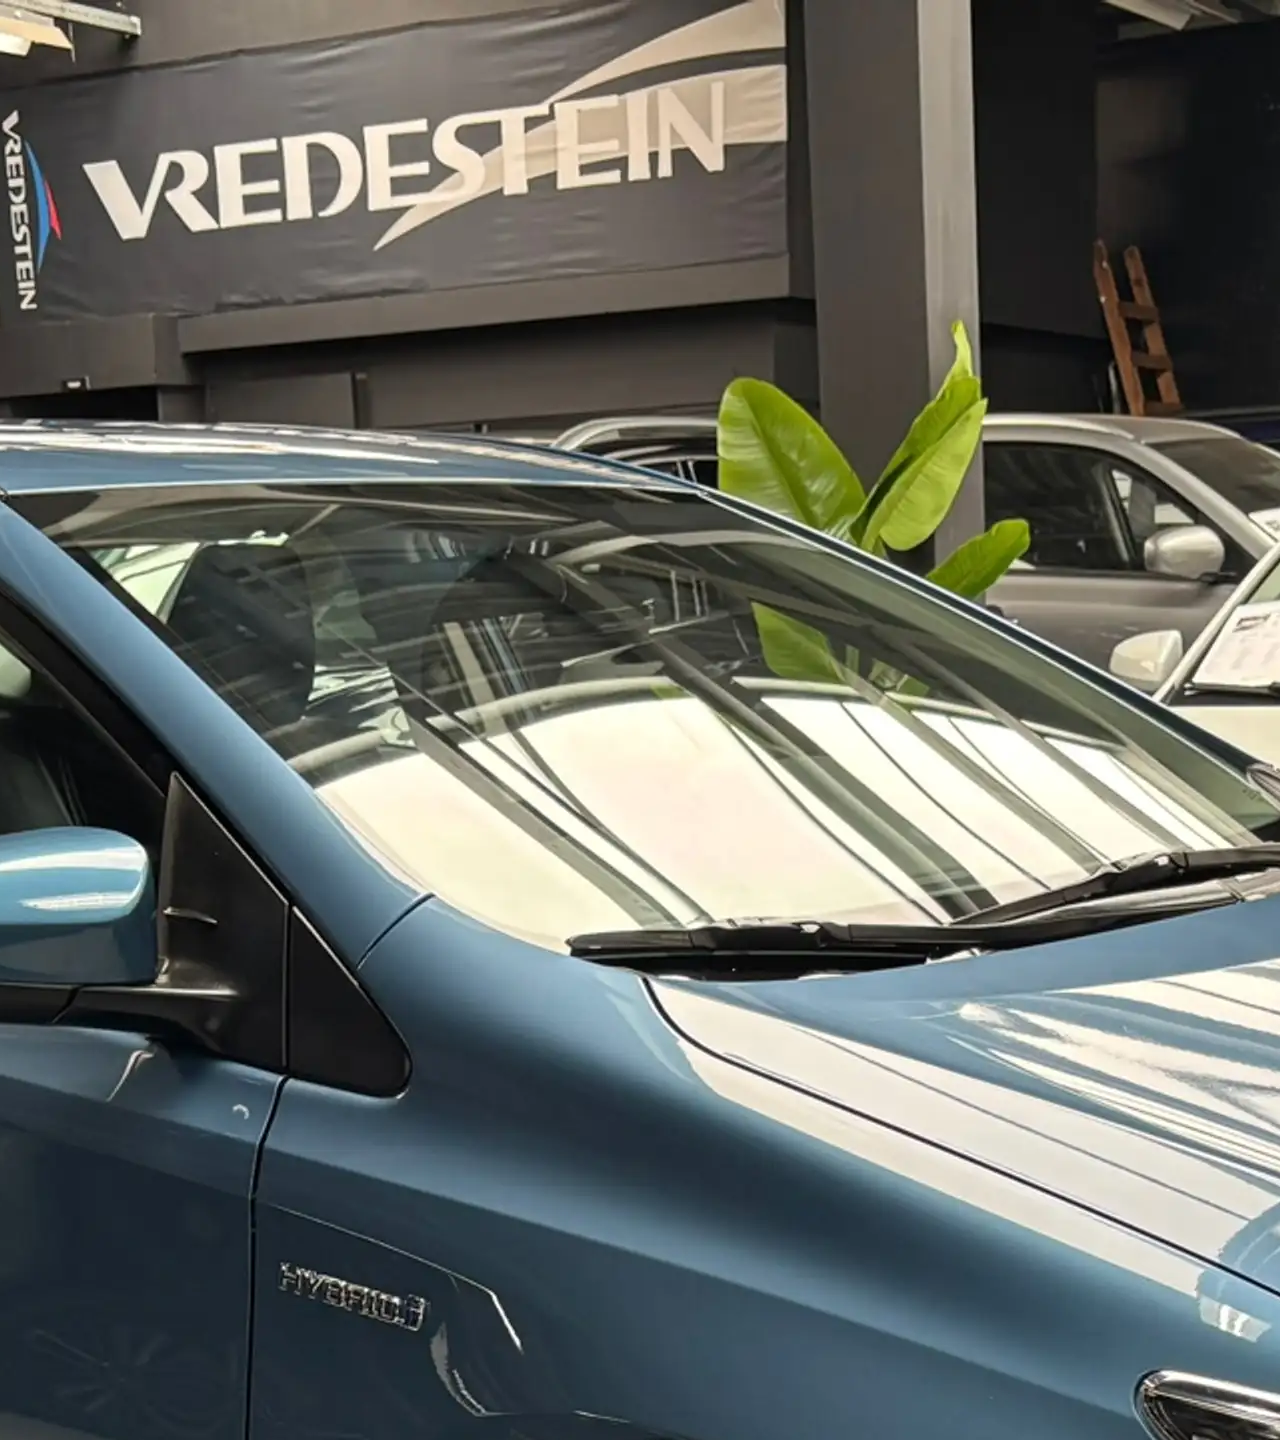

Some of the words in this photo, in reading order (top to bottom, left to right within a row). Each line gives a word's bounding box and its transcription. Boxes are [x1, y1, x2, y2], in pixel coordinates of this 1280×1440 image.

[2, 110, 37, 310] VREDESTEIN
[82, 80, 725, 241] VREDESTEIN
[278, 1261, 403, 1325] HYBRID
